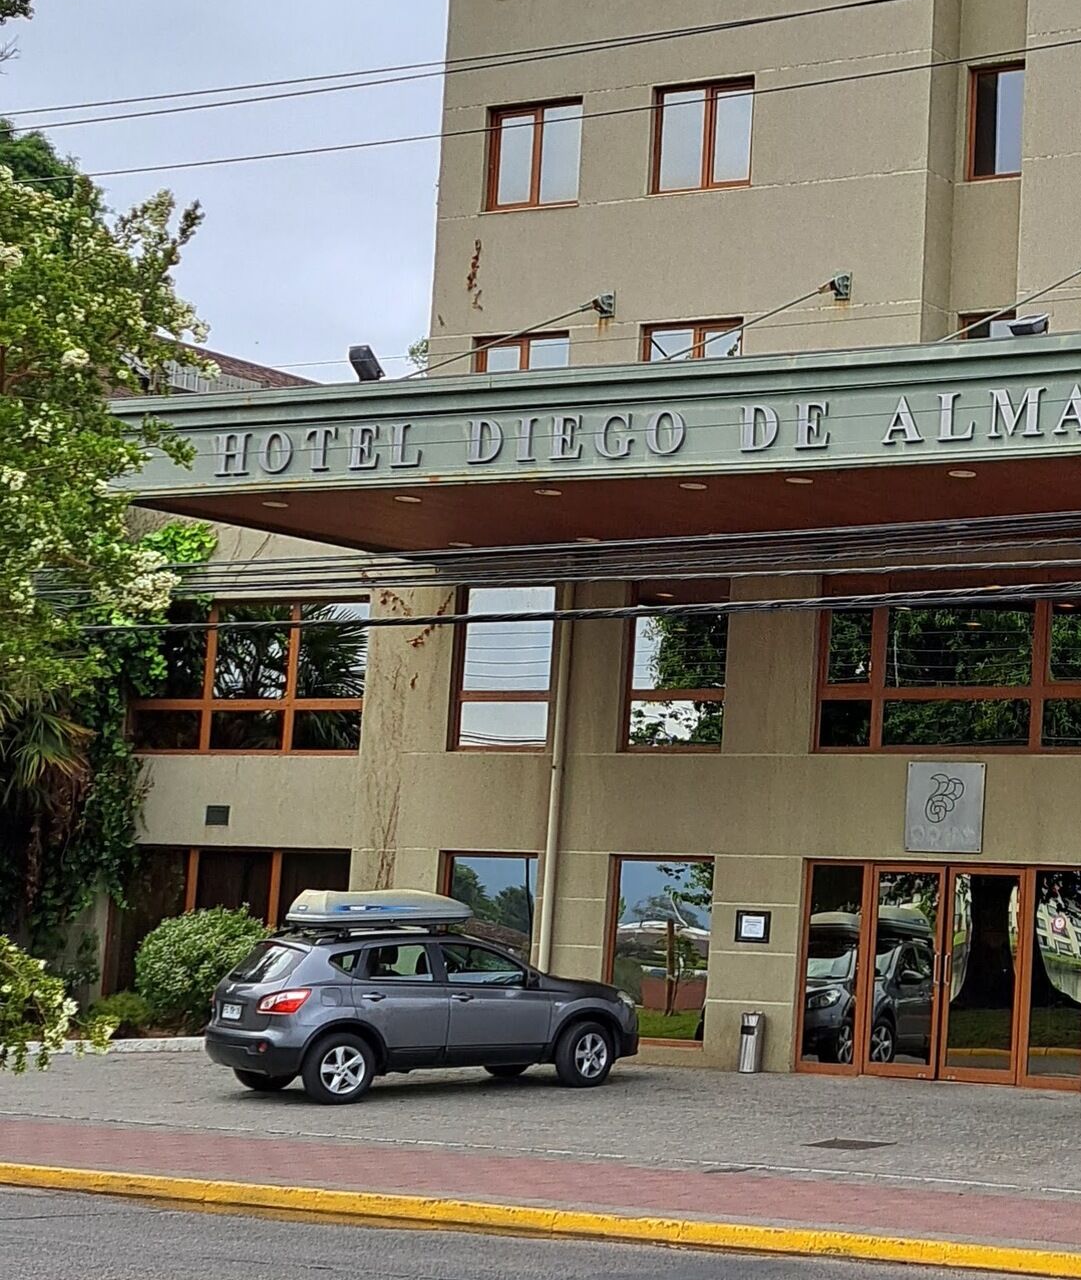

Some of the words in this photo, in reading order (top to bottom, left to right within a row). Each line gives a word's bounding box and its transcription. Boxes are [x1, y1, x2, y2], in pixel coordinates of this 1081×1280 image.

[214, 422, 423, 478] HOTEL
[466, 409, 687, 465] DIEGO
[739, 400, 830, 453] DE
